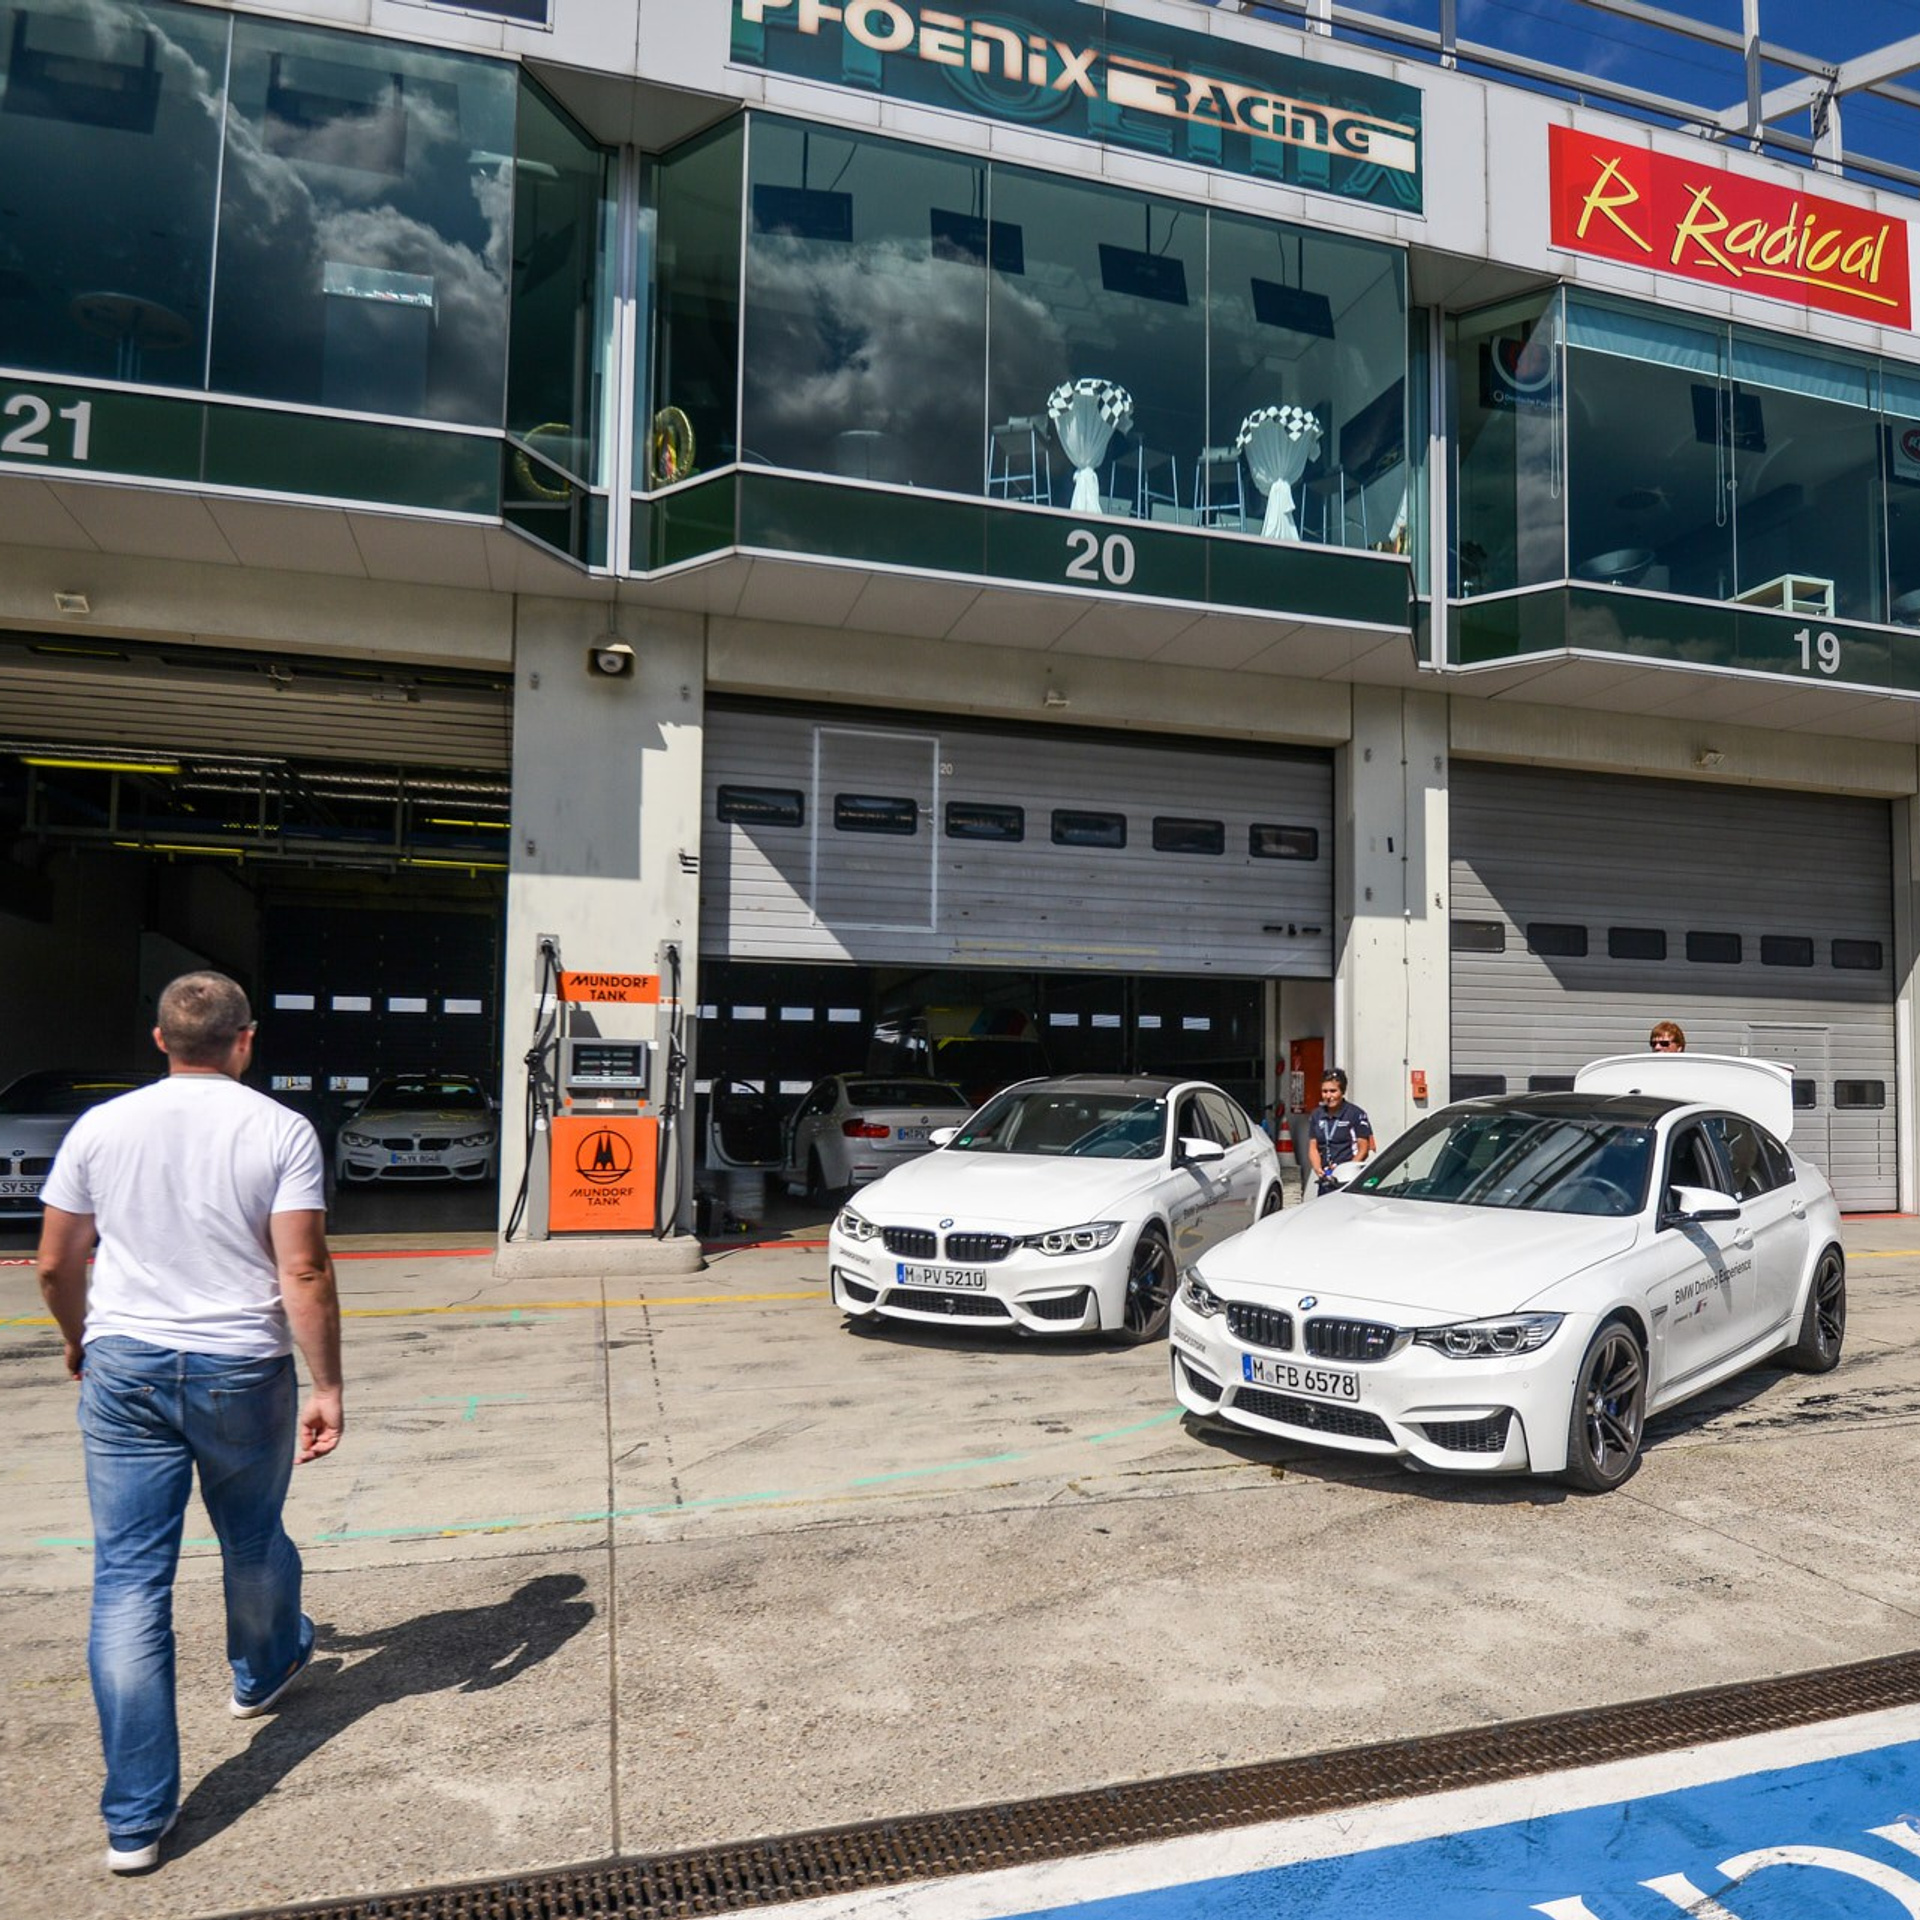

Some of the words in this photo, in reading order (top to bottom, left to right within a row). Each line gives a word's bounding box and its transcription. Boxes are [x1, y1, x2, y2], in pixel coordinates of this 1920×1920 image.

[1670, 182, 1890, 285] Radical
[1, 394, 92, 461] 21
[1065, 529, 1136, 586] 20
[1793, 627, 1841, 675] 19
[939, 762, 954, 775] 20
[568, 975, 649, 988] MUNDORF
[589, 989, 627, 1001] TANK
[2, 1182, 18, 1193] SY
[569, 1187, 635, 1197] MUNDORF
[587, 1197, 621, 1206] TANK
[905, 1266, 915, 1281] M
[924, 1269, 942, 1284] PV
[945, 1271, 984, 1287] 5210
[1675, 1283, 1695, 1306] BMW
[1694, 1274, 1719, 1296] Driving
[1718, 1259, 1752, 1285] Experience
[1252, 1358, 1265, 1381] M
[1275, 1363, 1300, 1387] FB
[1304, 1370, 1355, 1397] 6578
